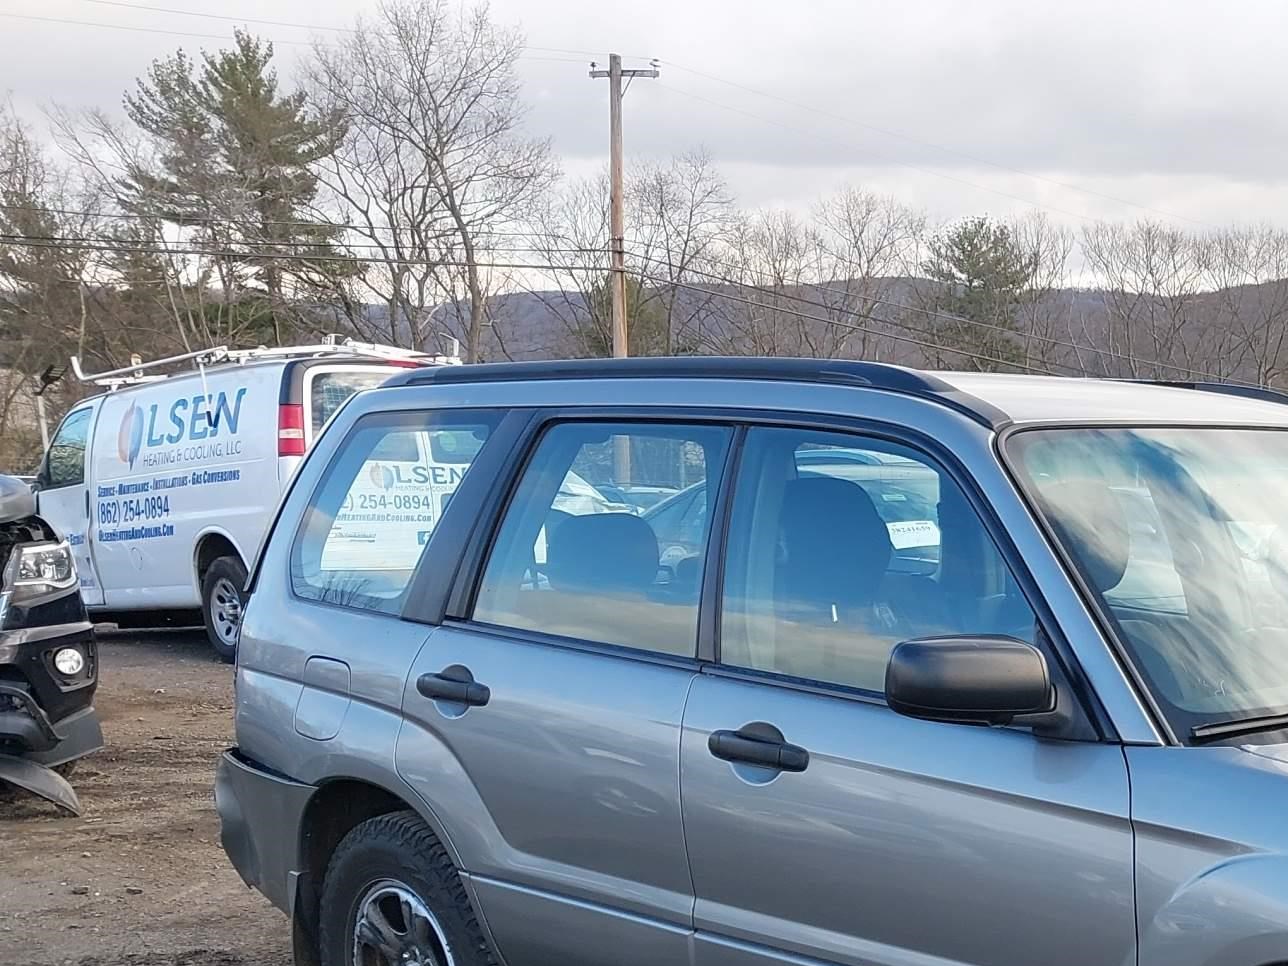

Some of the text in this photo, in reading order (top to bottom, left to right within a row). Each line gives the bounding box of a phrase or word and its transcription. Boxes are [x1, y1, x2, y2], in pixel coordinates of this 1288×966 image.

[143, 450, 175, 467] HEATING
[226, 440, 241, 456] LLC
[97, 495, 169, 528] (862) 254-0894
[359, 494, 430, 510] 254-0894
